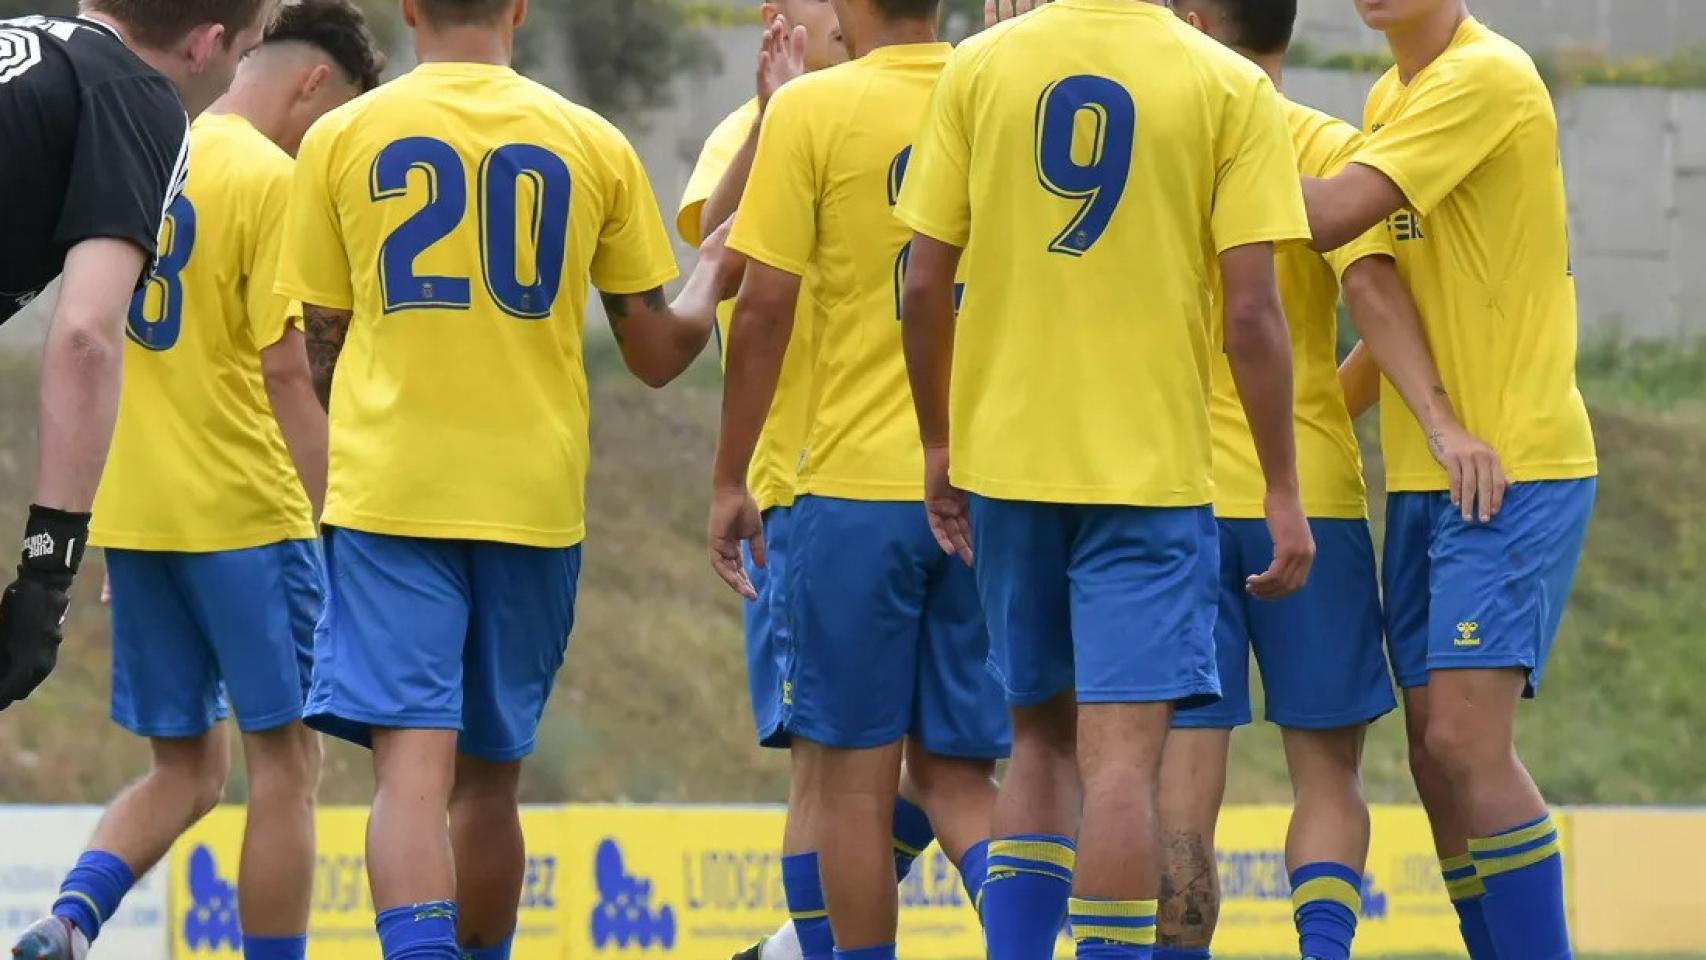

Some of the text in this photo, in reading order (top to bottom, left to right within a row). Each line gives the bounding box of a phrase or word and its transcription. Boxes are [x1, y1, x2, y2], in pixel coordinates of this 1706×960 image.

[369, 136, 572, 319] 20
[1034, 74, 1136, 257] 9
[125, 194, 197, 351] 8
